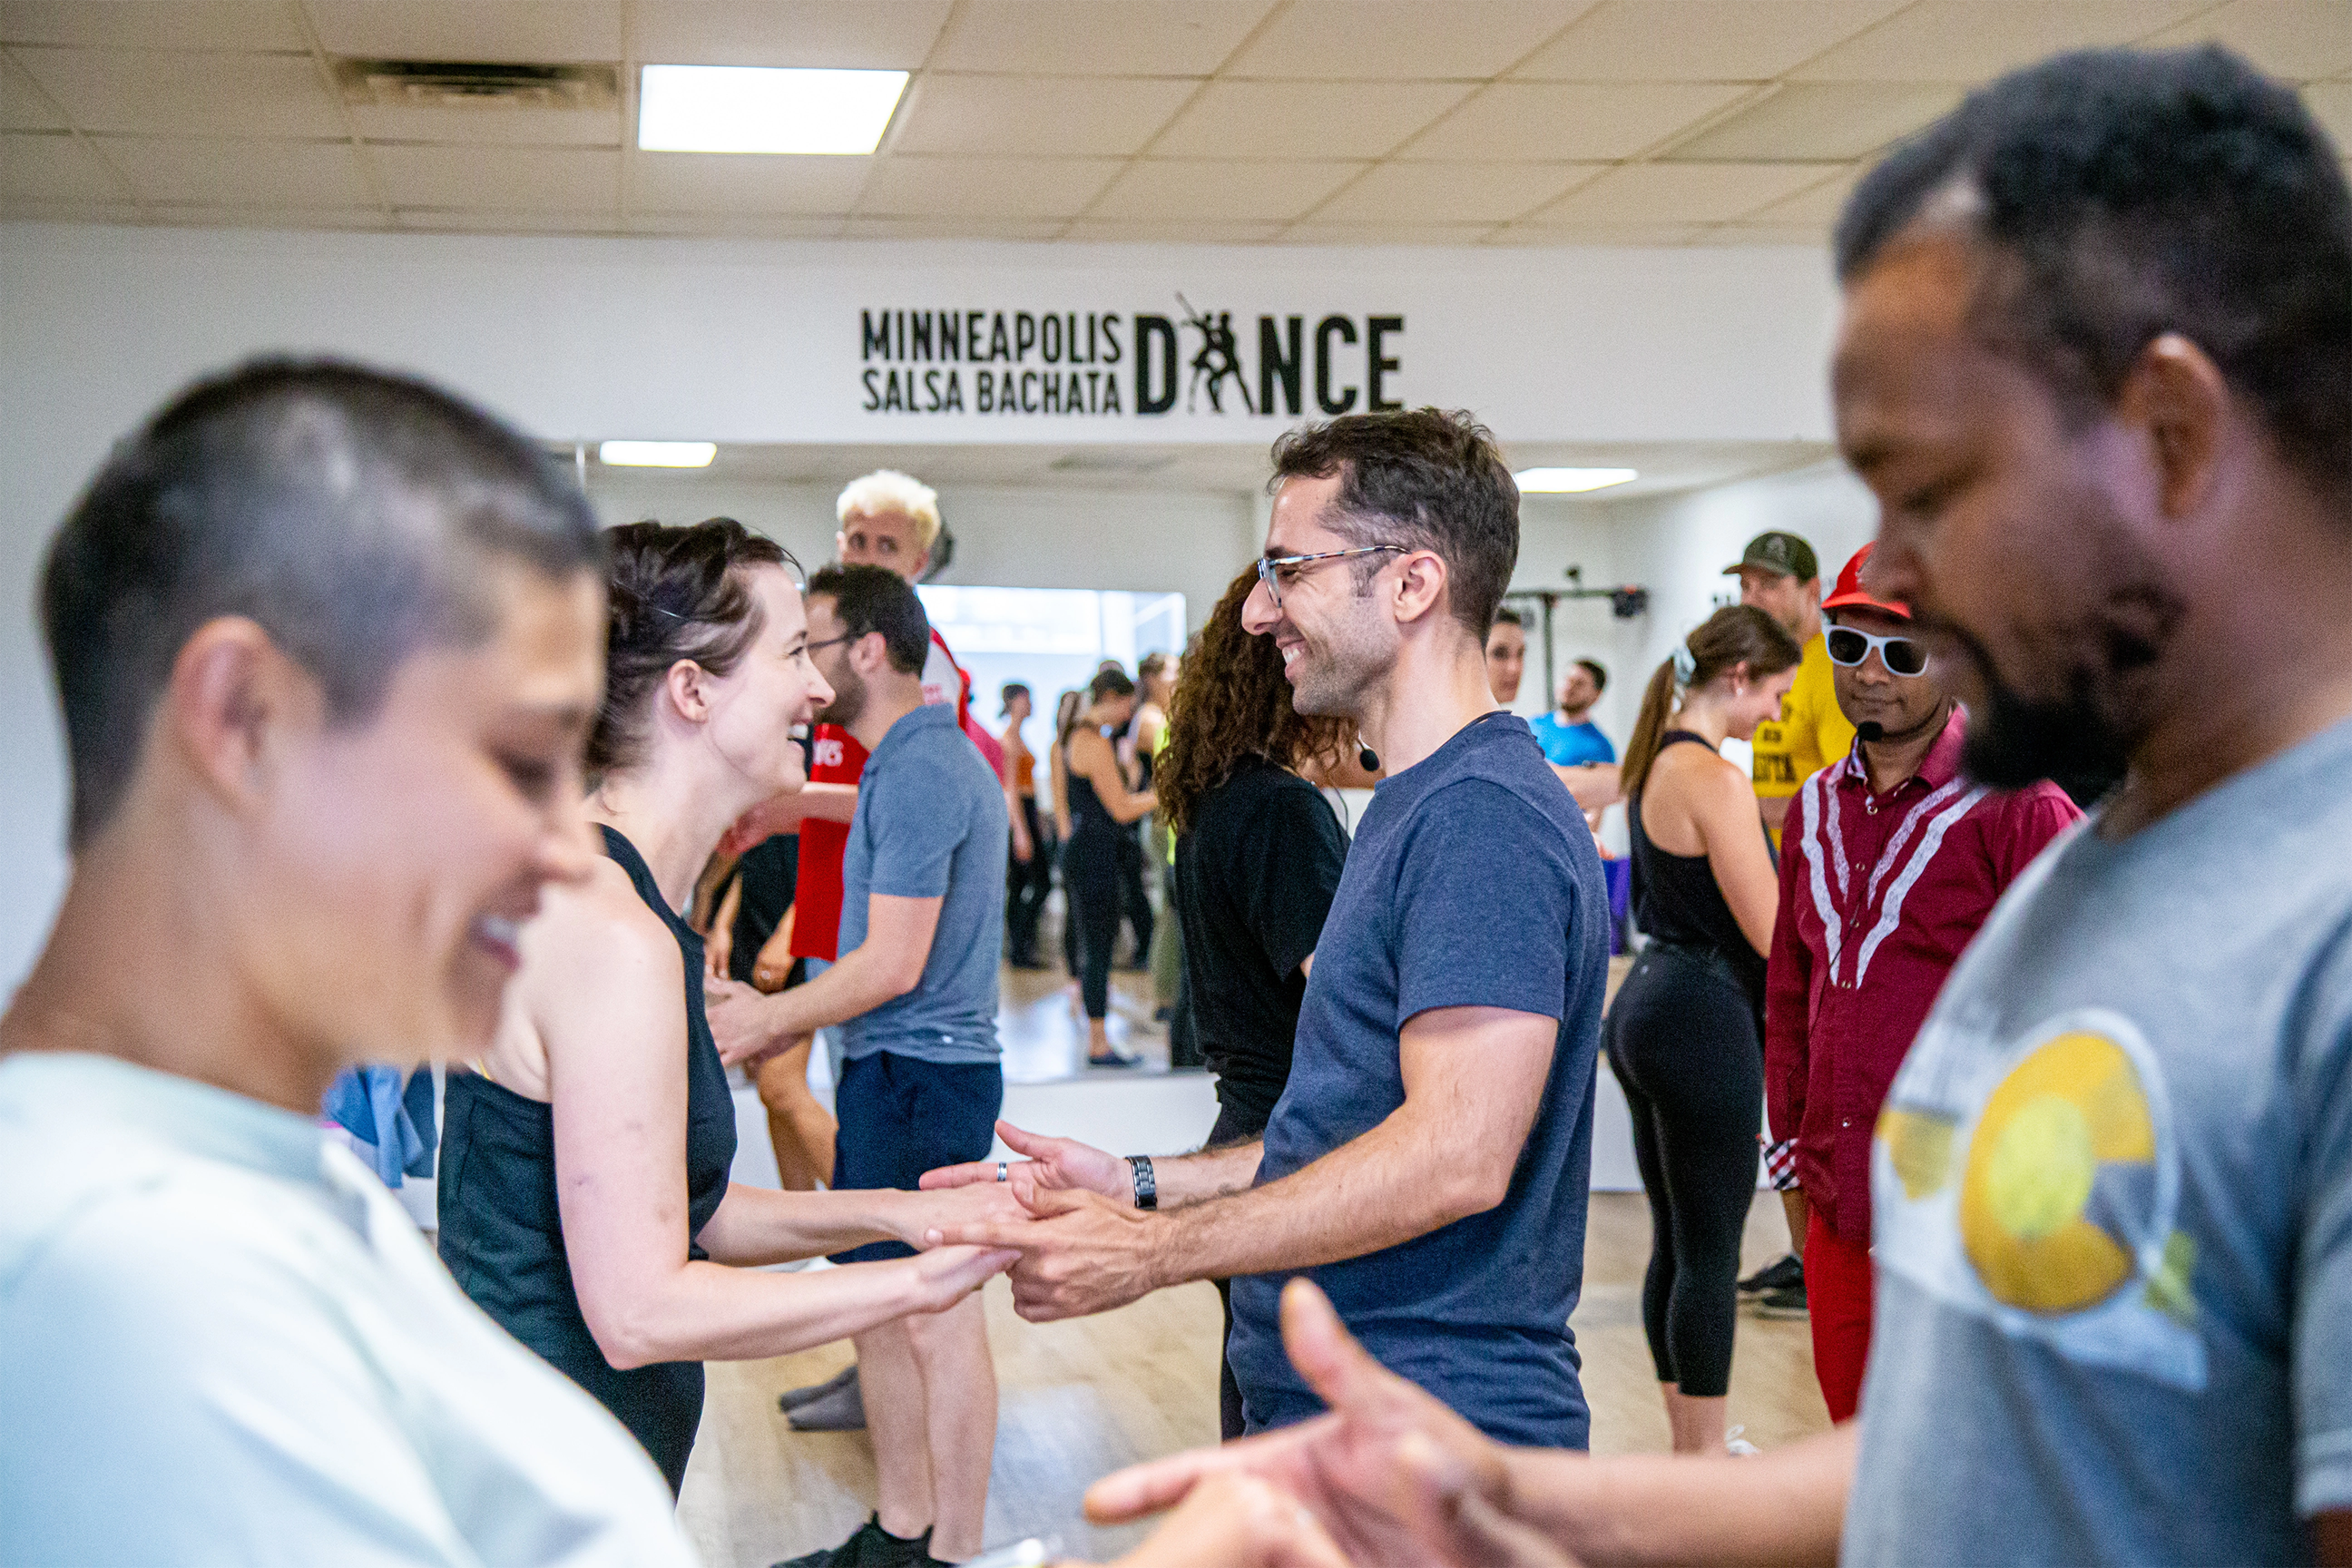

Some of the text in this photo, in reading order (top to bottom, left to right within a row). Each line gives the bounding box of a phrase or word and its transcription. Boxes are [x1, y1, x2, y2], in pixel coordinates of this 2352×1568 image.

[862, 309, 1122, 364] MINNEAPOLIS
[863, 368, 1122, 414] SALSA BACHATA
